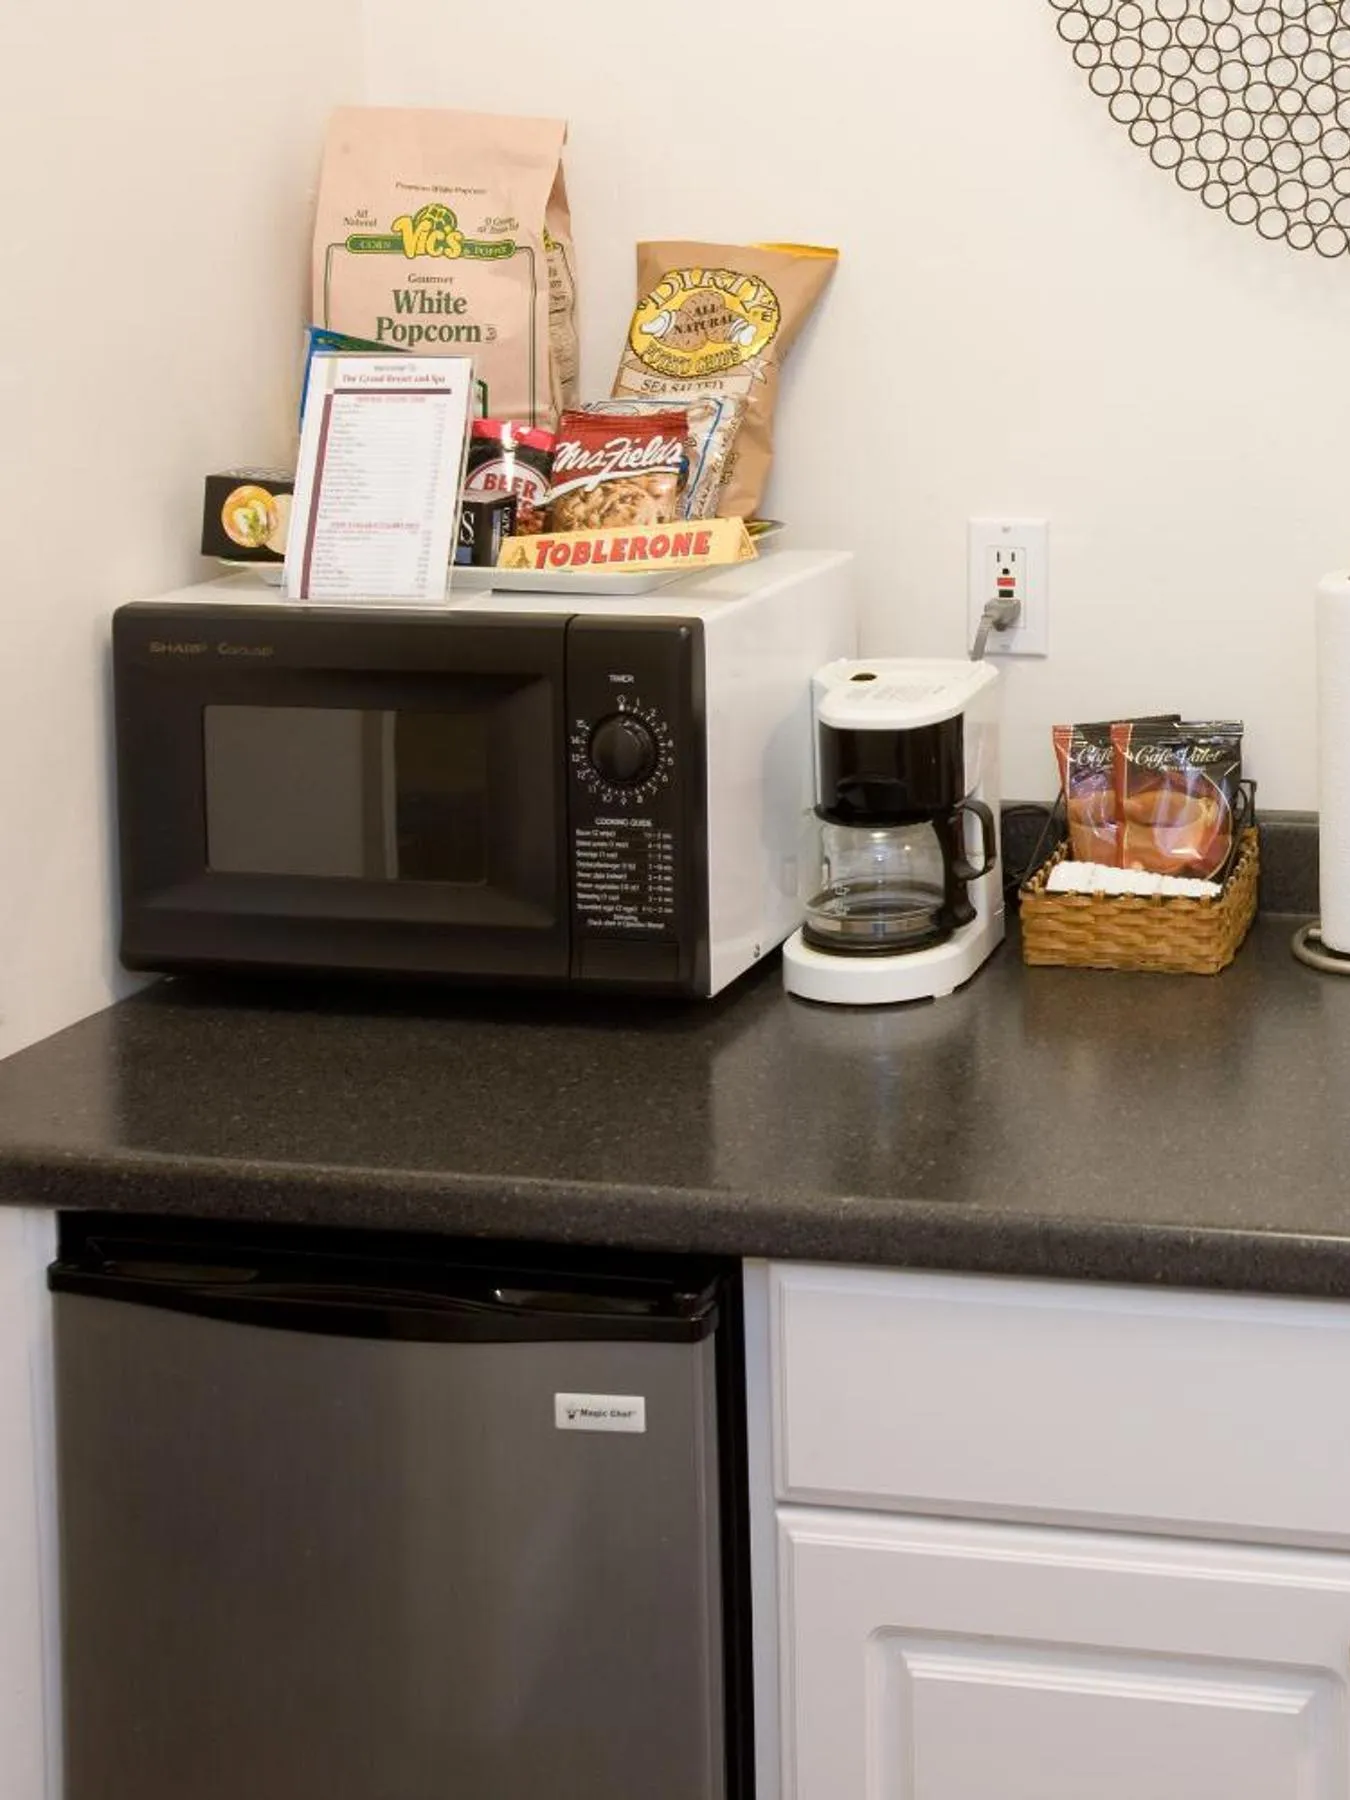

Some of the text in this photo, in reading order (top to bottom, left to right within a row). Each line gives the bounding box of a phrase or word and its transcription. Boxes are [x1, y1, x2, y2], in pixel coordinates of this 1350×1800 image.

[392, 289, 468, 315] White
[694, 303, 718, 316] ALL
[375, 316, 482, 347] Popcorn
[673, 313, 734, 335] NATURAL
[640, 379, 667, 394] SEA
[534, 530, 713, 570] TOBLERONE
[580, 1409, 632, 1418] Magic Chef
